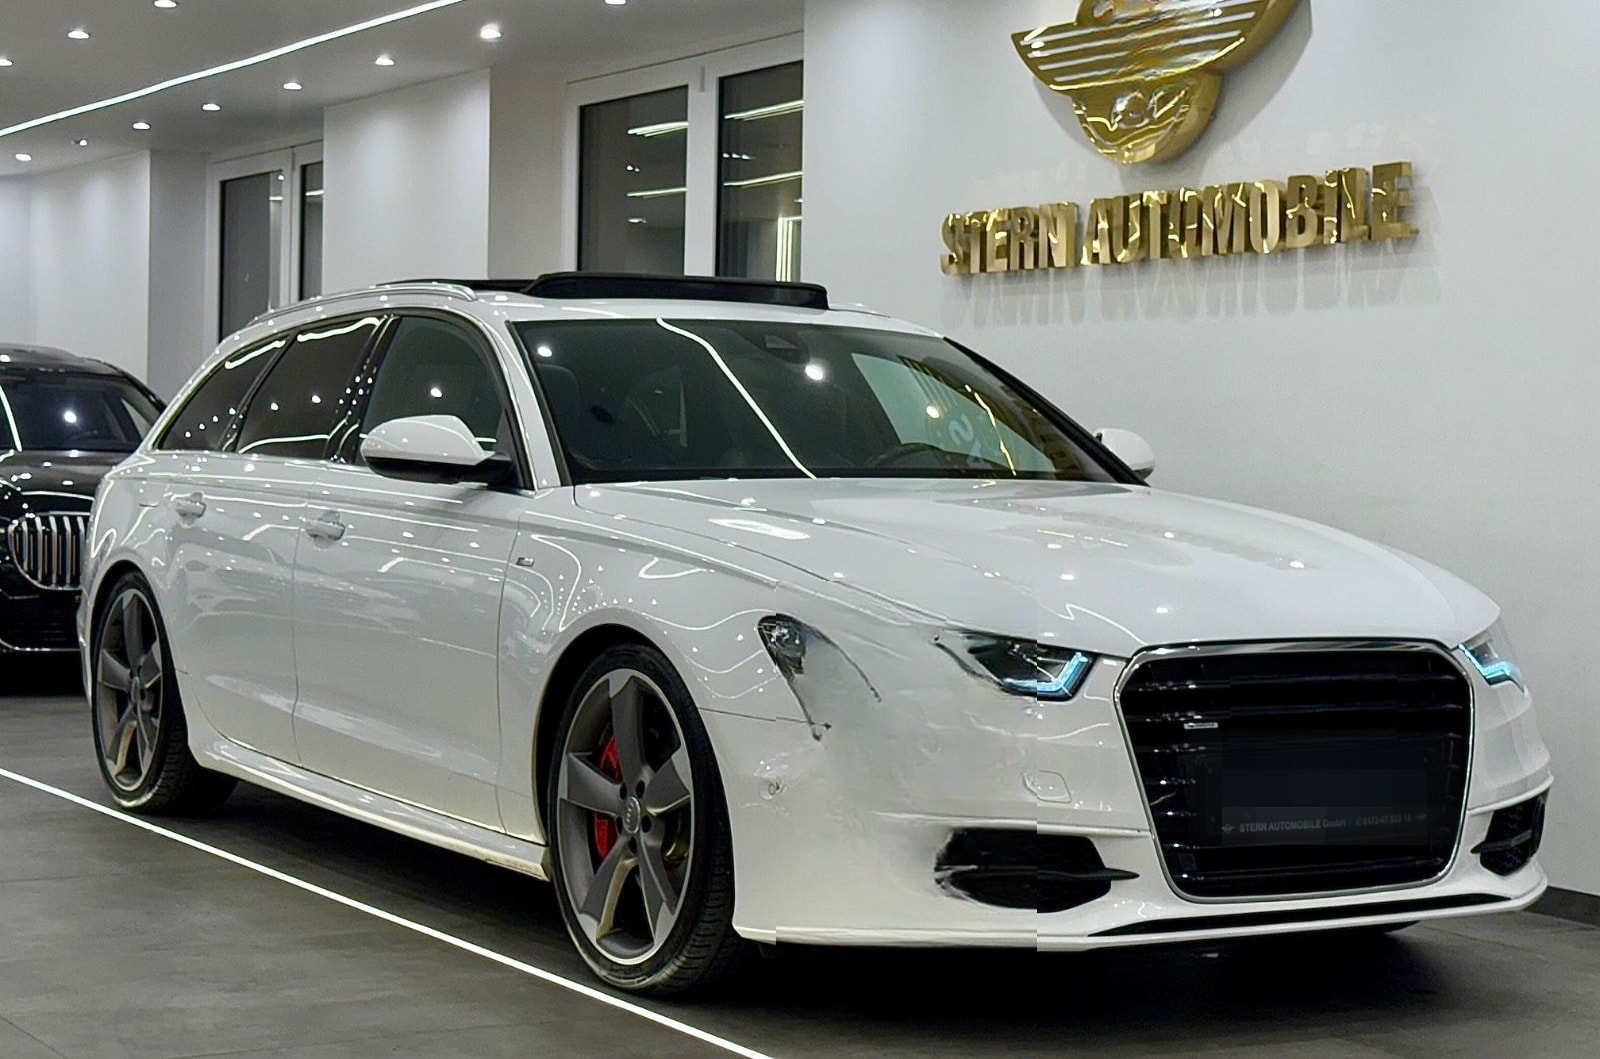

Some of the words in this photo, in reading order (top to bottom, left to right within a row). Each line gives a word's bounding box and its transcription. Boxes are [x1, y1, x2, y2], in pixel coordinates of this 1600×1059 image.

[940, 202, 1078, 275] STERN
[1082, 161, 1418, 265] AUTOMOBILE
[1239, 822, 1267, 832] STERN
[1269, 819, 1321, 831] AUTOMOBILE
